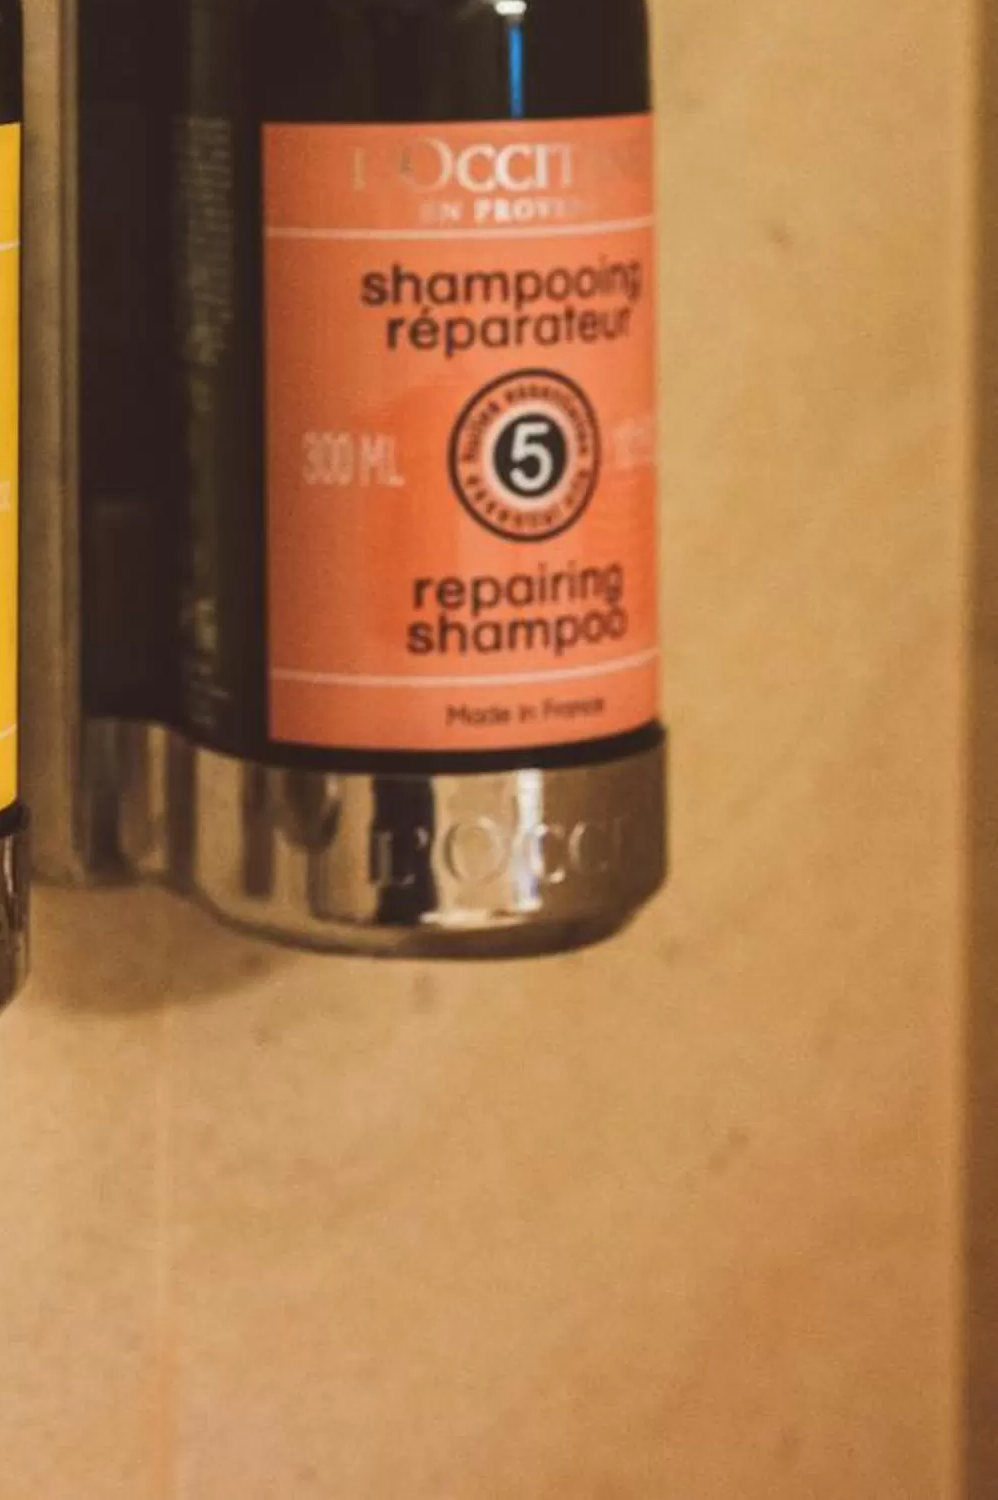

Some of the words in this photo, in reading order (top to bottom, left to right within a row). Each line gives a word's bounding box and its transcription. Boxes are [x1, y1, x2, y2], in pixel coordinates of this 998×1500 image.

[361, 255, 642, 308] shampooing
[387, 303, 631, 357] réparateur
[509, 421, 555, 492] 5
[413, 561, 624, 616] repairing
[407, 607, 627, 655] shampoo
[445, 703, 512, 728] Made
[518, 704, 538, 724] in
[543, 697, 607, 721] France
